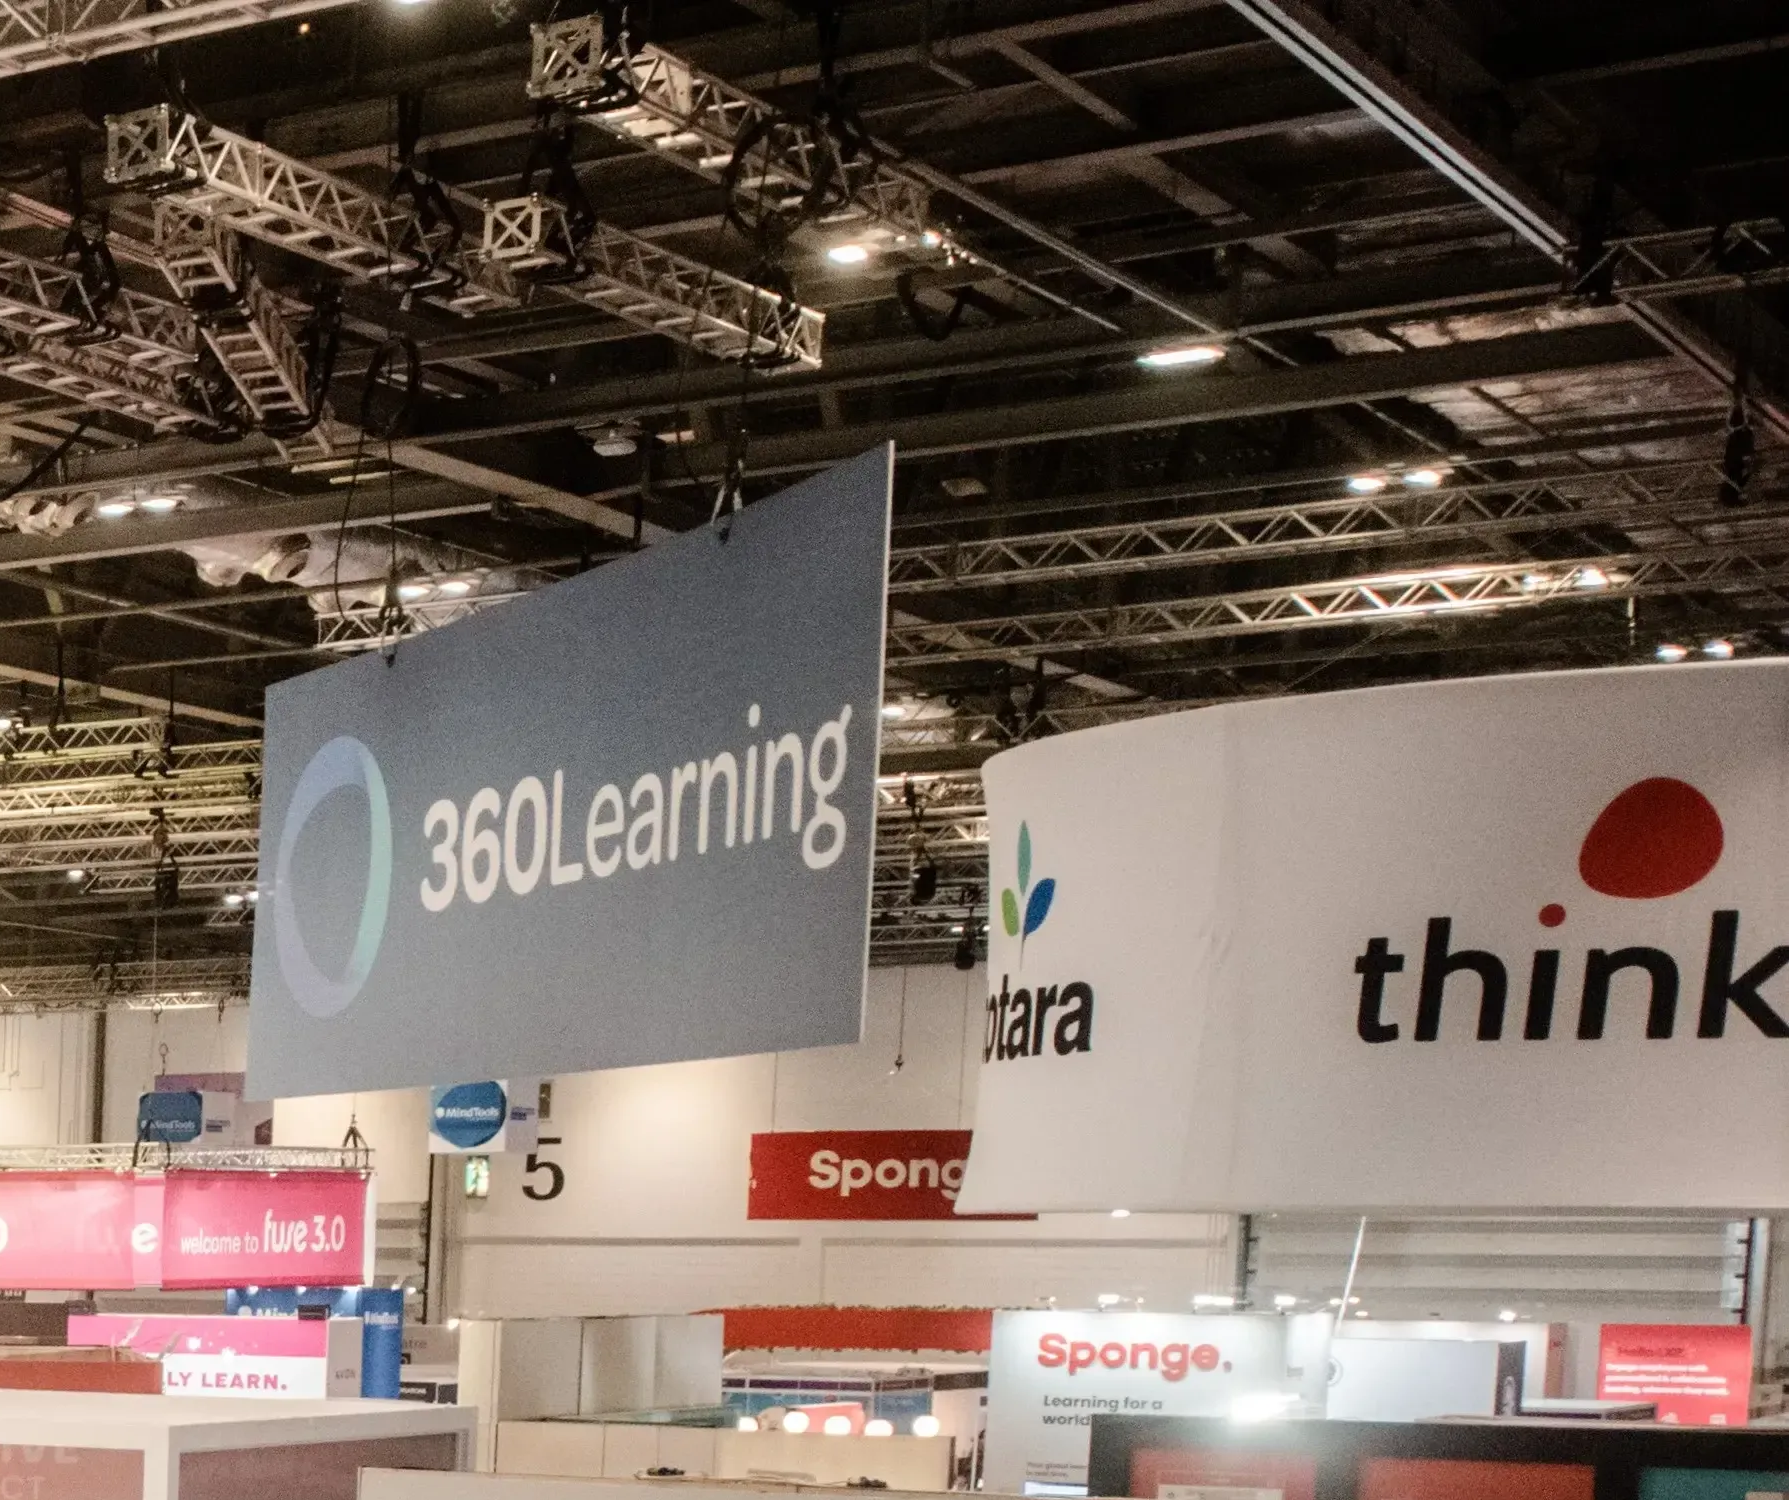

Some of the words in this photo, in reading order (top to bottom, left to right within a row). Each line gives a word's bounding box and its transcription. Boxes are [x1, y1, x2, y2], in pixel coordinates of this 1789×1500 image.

[420, 703, 852, 913] 360Learning
[1355, 903, 1789, 1043] think
[444, 1106, 500, 1119] MindTools
[522, 1137, 565, 1201] 5
[181, 1227, 241, 1256] welcome
[244, 1231, 260, 1255] to
[263, 1208, 309, 1254] fuse
[312, 1213, 346, 1255] 3.0
[202, 1370, 288, 1392] LEARN.
[1037, 1332, 1233, 1382] Sponge.
[1042, 1413, 1090, 1426] world
[1043, 1395, 1120, 1412] Learning
[1123, 1396, 1147, 1411] for
[1152, 1400, 1163, 1410] a
